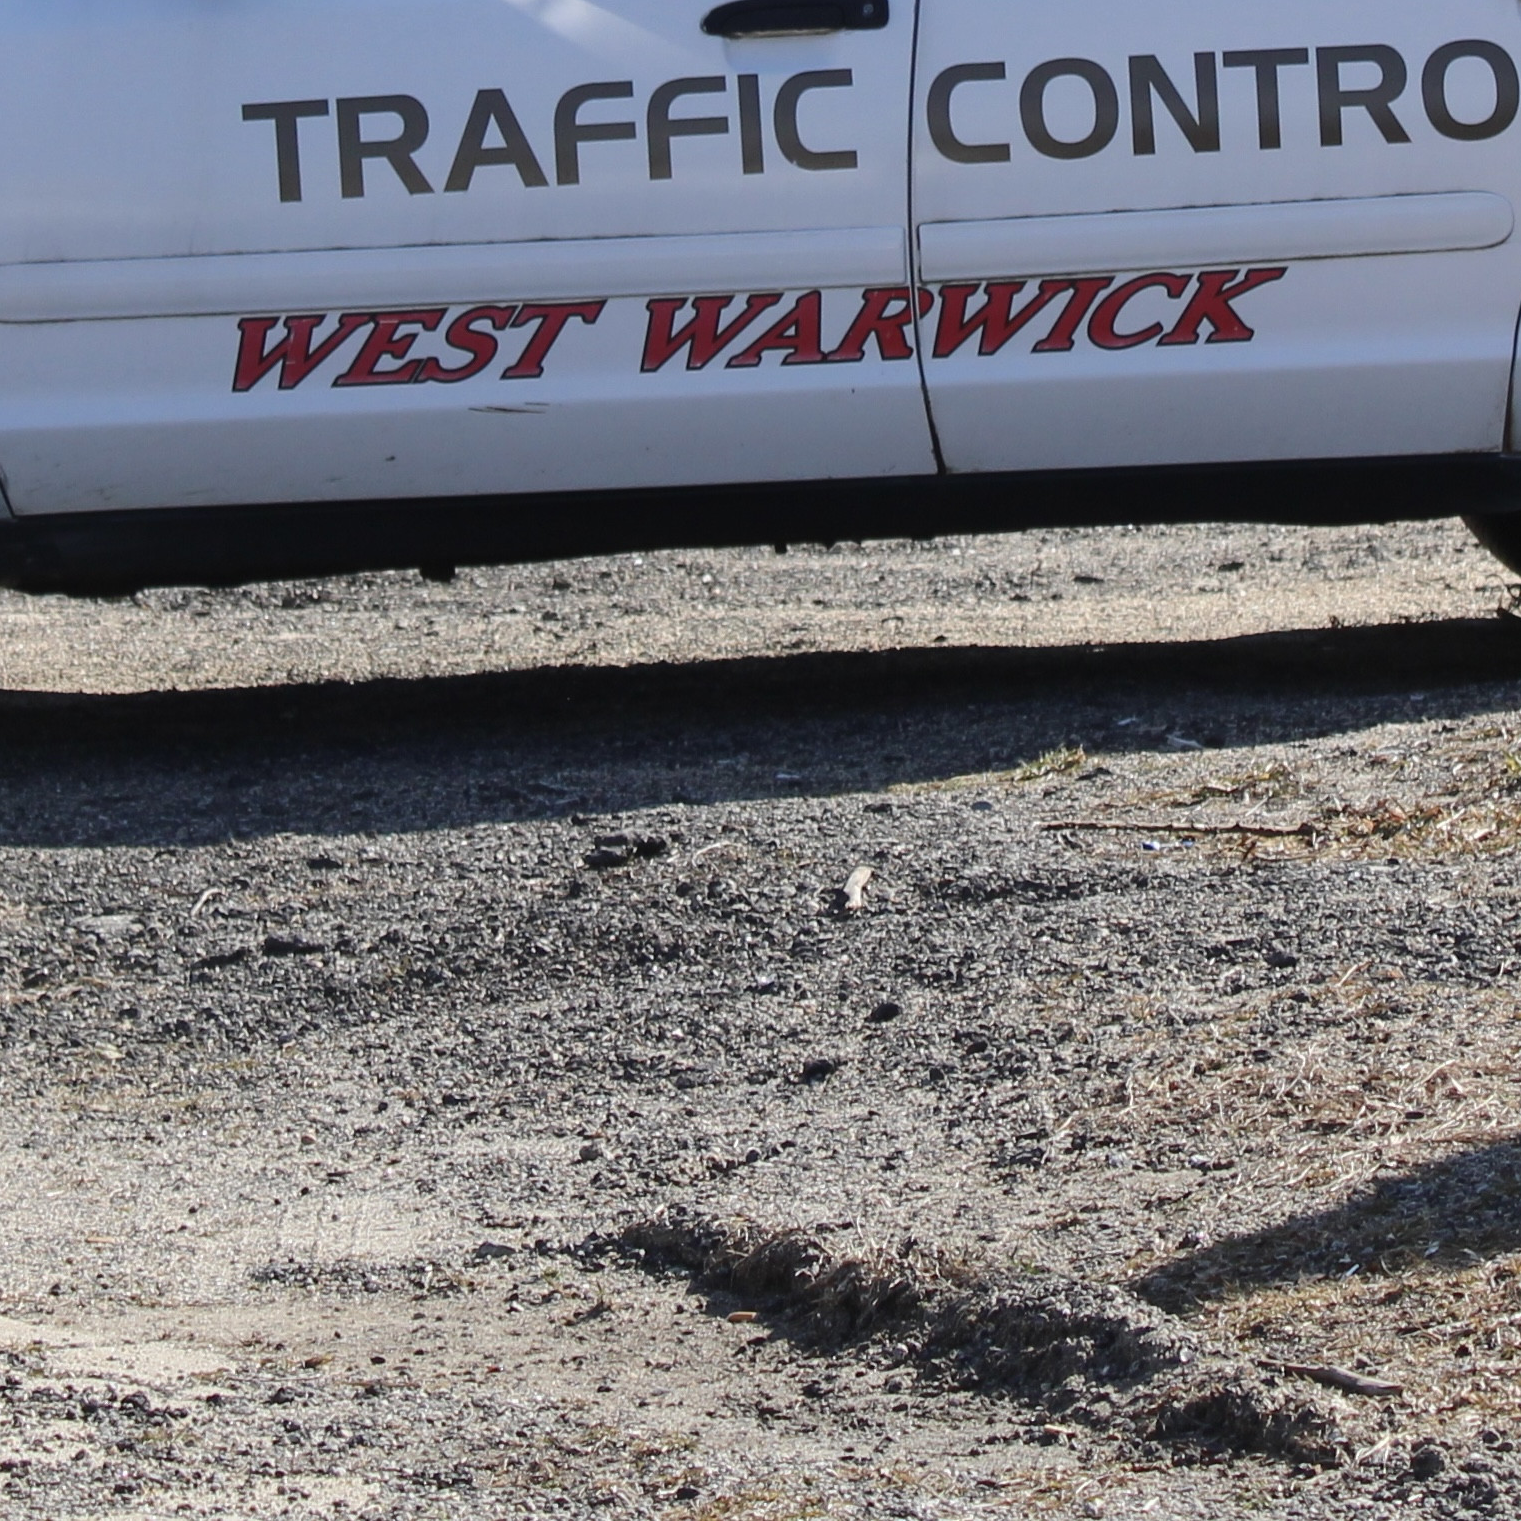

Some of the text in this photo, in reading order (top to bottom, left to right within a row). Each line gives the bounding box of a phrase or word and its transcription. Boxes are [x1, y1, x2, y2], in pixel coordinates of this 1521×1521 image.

[241, 67, 859, 204] TRAFFIC
[231, 265, 1289, 393] WEST WARWICK
